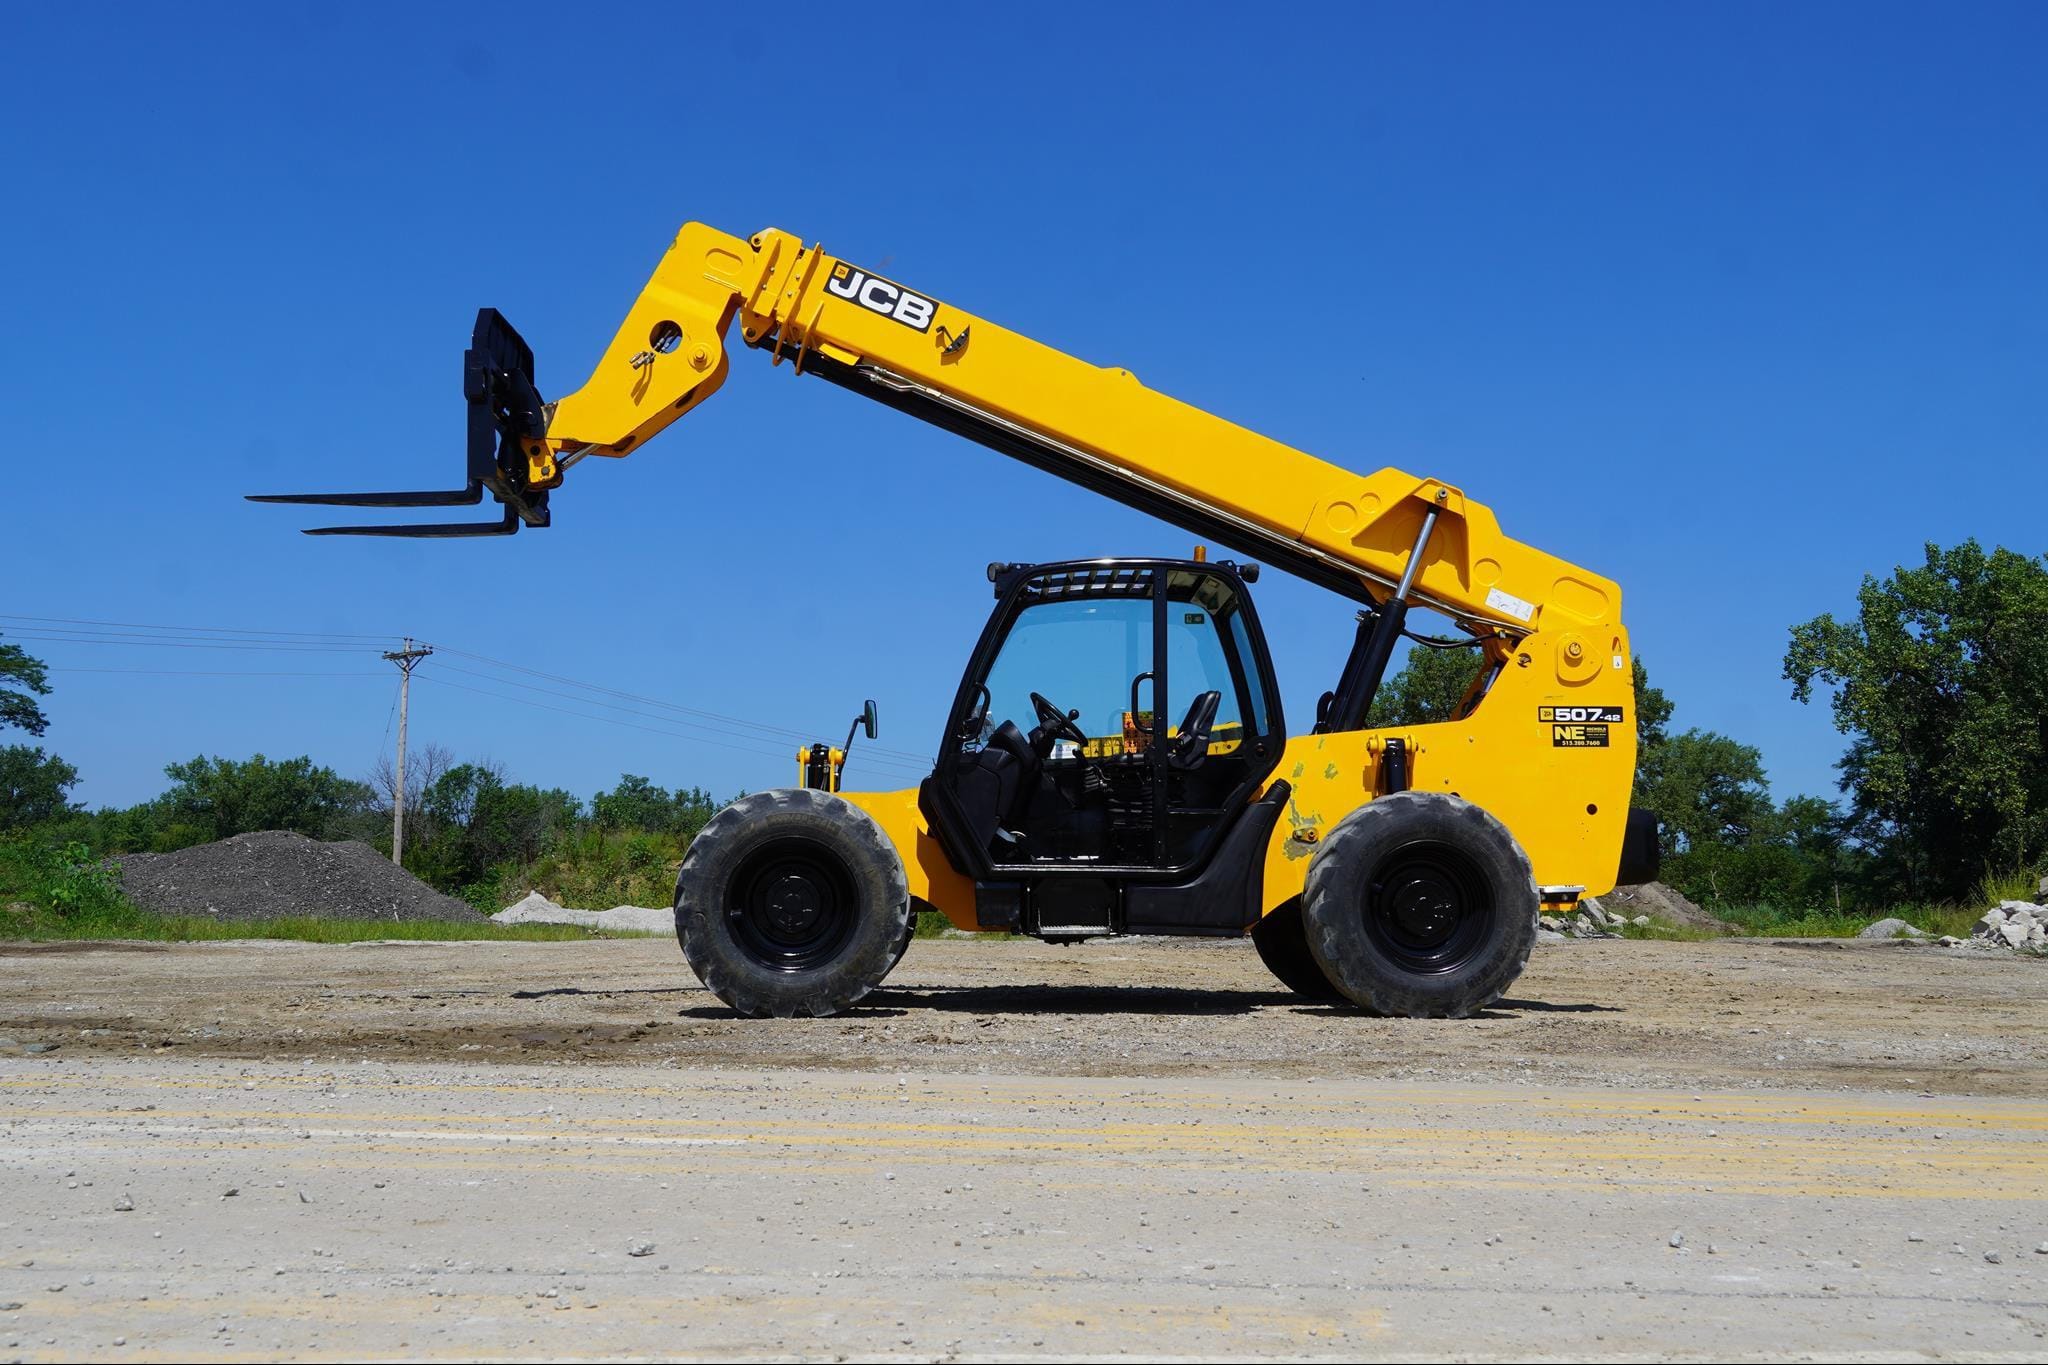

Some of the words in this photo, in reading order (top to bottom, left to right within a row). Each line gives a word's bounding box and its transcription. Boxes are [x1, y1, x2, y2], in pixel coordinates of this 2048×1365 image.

[829, 271, 934, 329] JCB
[1555, 708, 1621, 722] 507-42
[1554, 726, 1585, 740] NE
